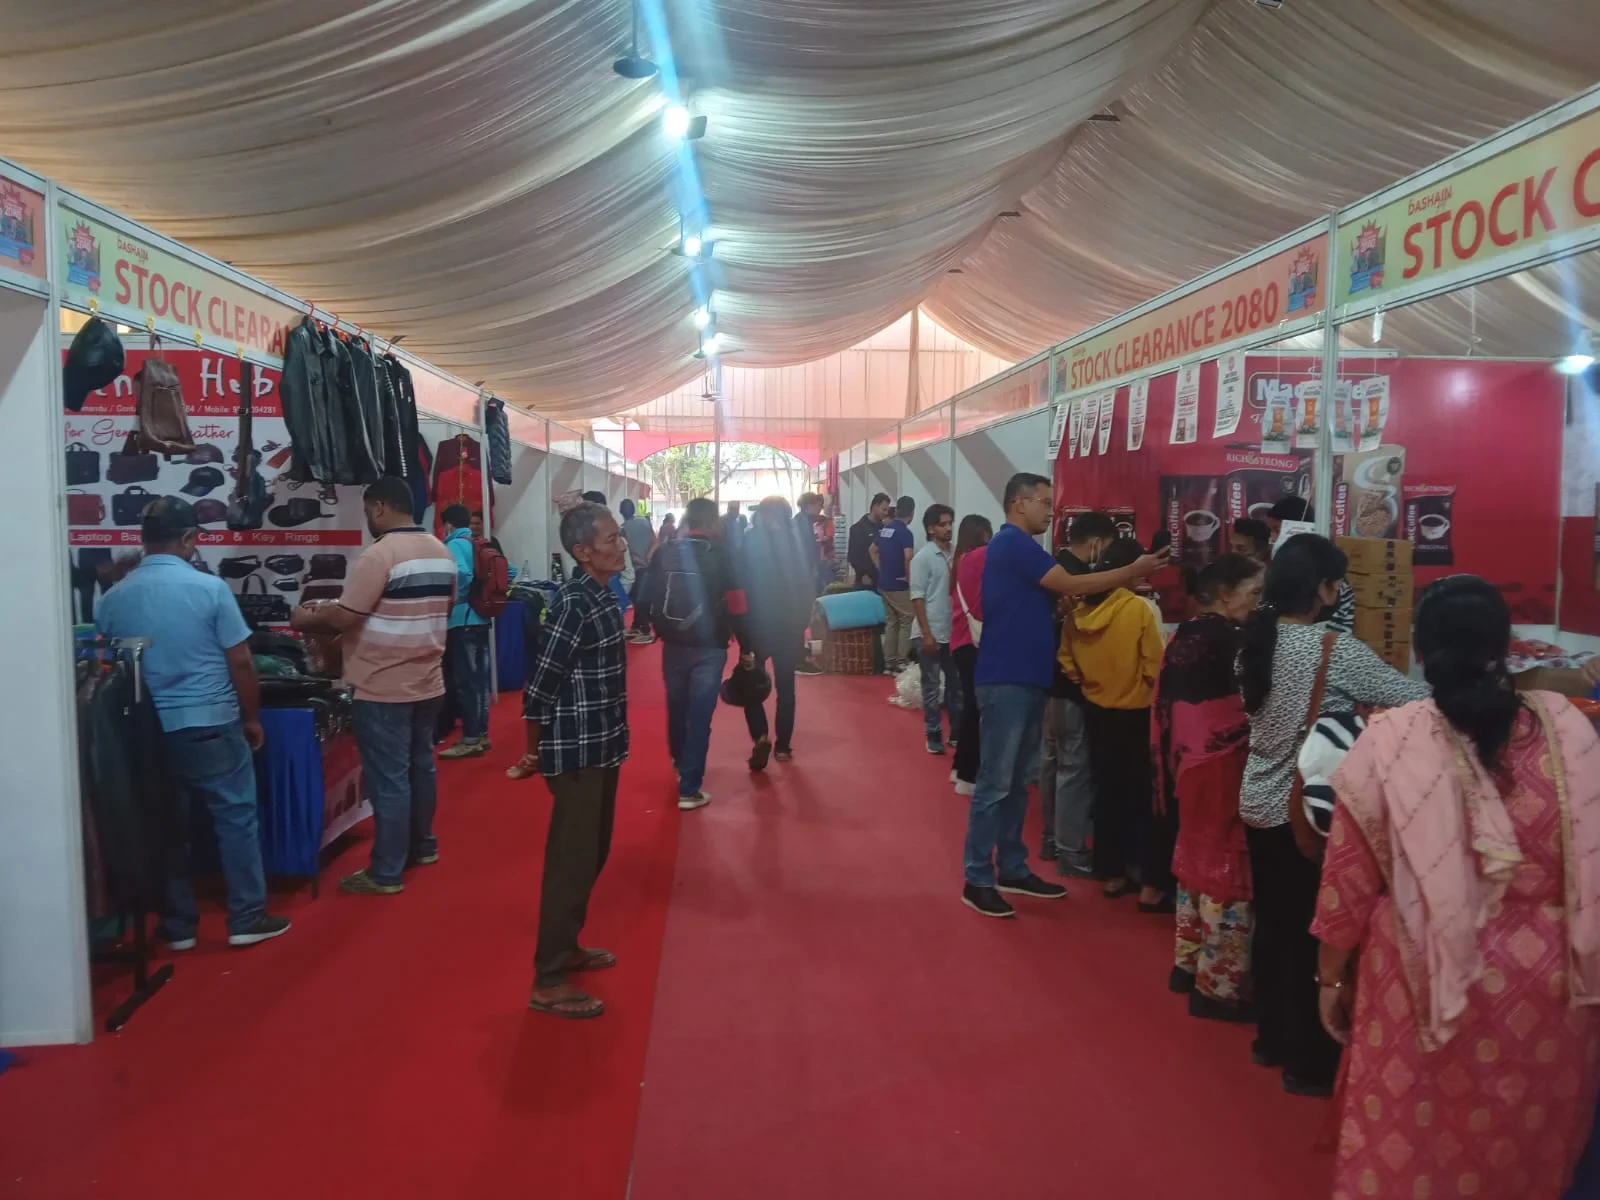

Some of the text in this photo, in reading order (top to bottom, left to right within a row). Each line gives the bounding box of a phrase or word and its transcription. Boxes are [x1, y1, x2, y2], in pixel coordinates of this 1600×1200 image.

[1402, 166, 1558, 280] STOCK
[115, 259, 204, 329] STOCK
[1071, 281, 1280, 390] STOCK CLEARANCE 2080
[64, 421, 86, 444] for
[190, 424, 234, 440] ather
[70, 532, 113, 543] Laptop
[198, 532, 224, 543] Cap
[252, 532, 276, 543] Key
[284, 532, 320, 543] Rings
[1335, 483, 1348, 538] acCoffee
